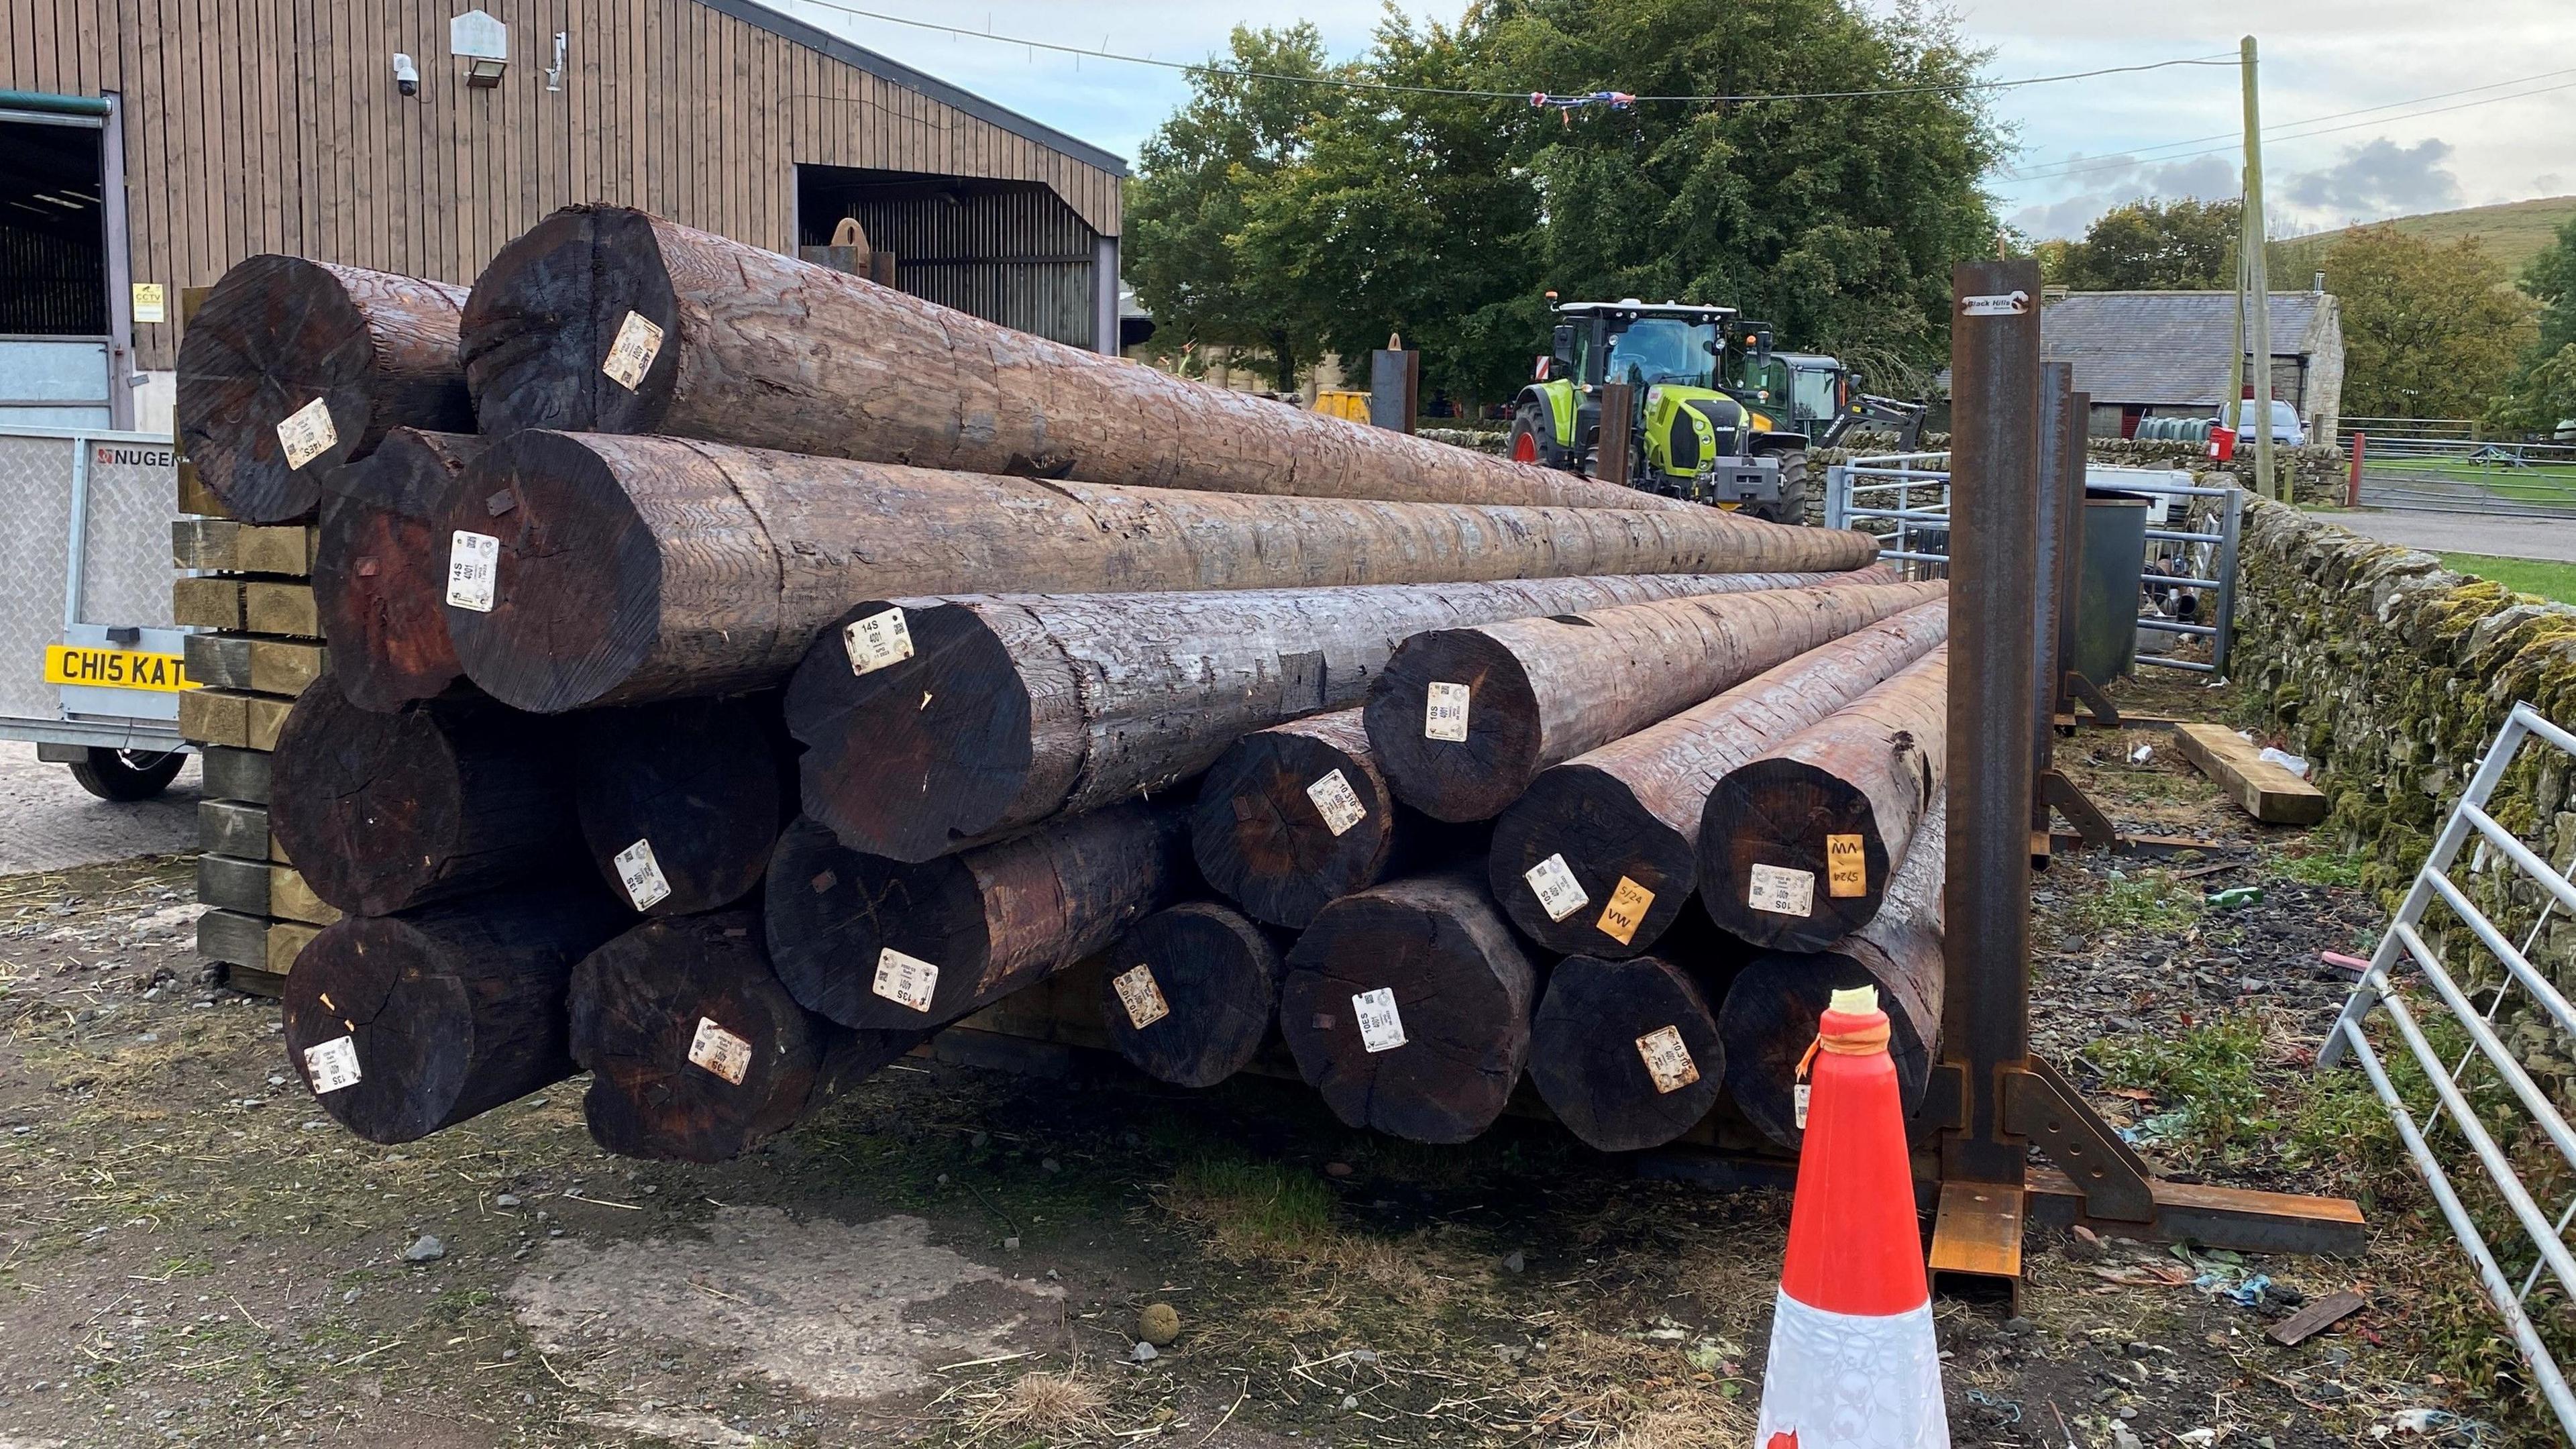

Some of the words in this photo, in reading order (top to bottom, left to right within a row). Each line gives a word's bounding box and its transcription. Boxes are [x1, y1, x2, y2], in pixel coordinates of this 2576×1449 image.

[631, 344, 643, 360] 4001
[637, 347, 653, 372] 14ES
[1824, 413, 1845, 438] VOLVO
[303, 440, 321, 457] 14ES
[452, 562, 462, 582] 14S
[463, 564, 473, 580] 4001
[861, 619, 879, 633] 14S
[869, 631, 881, 643] 4001
[63, 651, 123, 681] CH15
[131, 656, 185, 686] KAT
[1430, 705, 1438, 720] 10S
[1439, 706, 1448, 718] 4001
[1334, 793, 1346, 806] 4001
[1338, 782, 1356, 807] 10.310
[1831, 842, 1857, 854] VW
[626, 876, 638, 893] 13S
[633, 872, 644, 885] 4001
[1540, 890, 1553, 906] 10S
[1548, 886, 1560, 897] 4001
[1776, 889, 1789, 899] 4001
[1774, 900, 1791, 910] 10S
[1608, 908, 1631, 928] VW
[898, 978, 912, 990] 4001
[896, 989, 912, 1002] 13S
[1121, 989, 1138, 1014] 10.310
[1360, 1012, 1371, 1034] 10ES
[1371, 1016, 1380, 1028] 4001
[1665, 1050, 1676, 1061] 4001
[1672, 1040, 1690, 1067] 10.310
[710, 1060, 726, 1074] 13S
[331, 1075, 345, 1085] 13S
